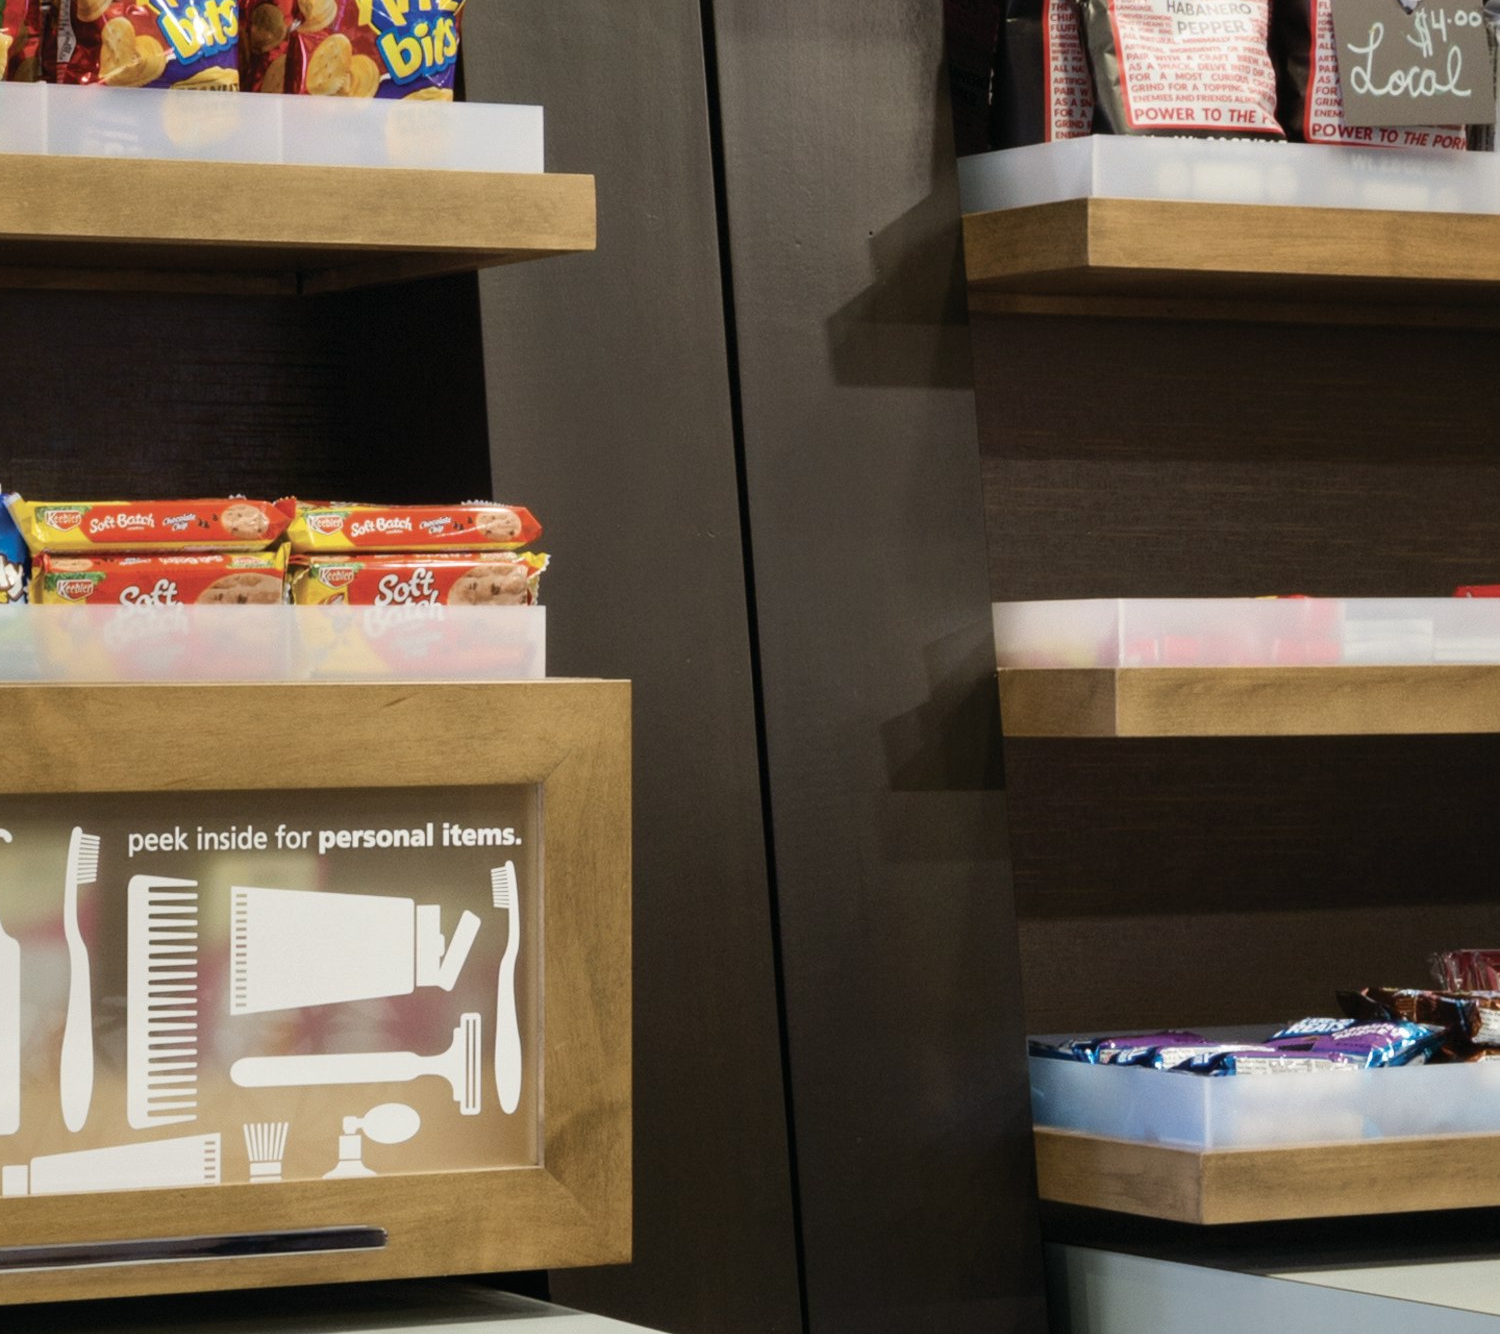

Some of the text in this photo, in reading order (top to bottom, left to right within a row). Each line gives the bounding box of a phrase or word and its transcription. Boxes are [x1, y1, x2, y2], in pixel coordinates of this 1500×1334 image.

[1167, 0, 1251, 16] HABANERO
[1178, 20, 1246, 35] PEPPER
[1407, 8, 1482, 58] $4.00
[380, 18, 457, 79] bits
[1348, 22, 1471, 98] Local
[1135, 108, 1256, 123] POWER TO THE
[1312, 123, 1430, 146] POWER TO THE
[90, 513, 155, 534] Soft Batch
[351, 517, 413, 537] Soft Batch
[374, 567, 435, 607] Soft
[128, 823, 522, 857] peek inside for personal items.
